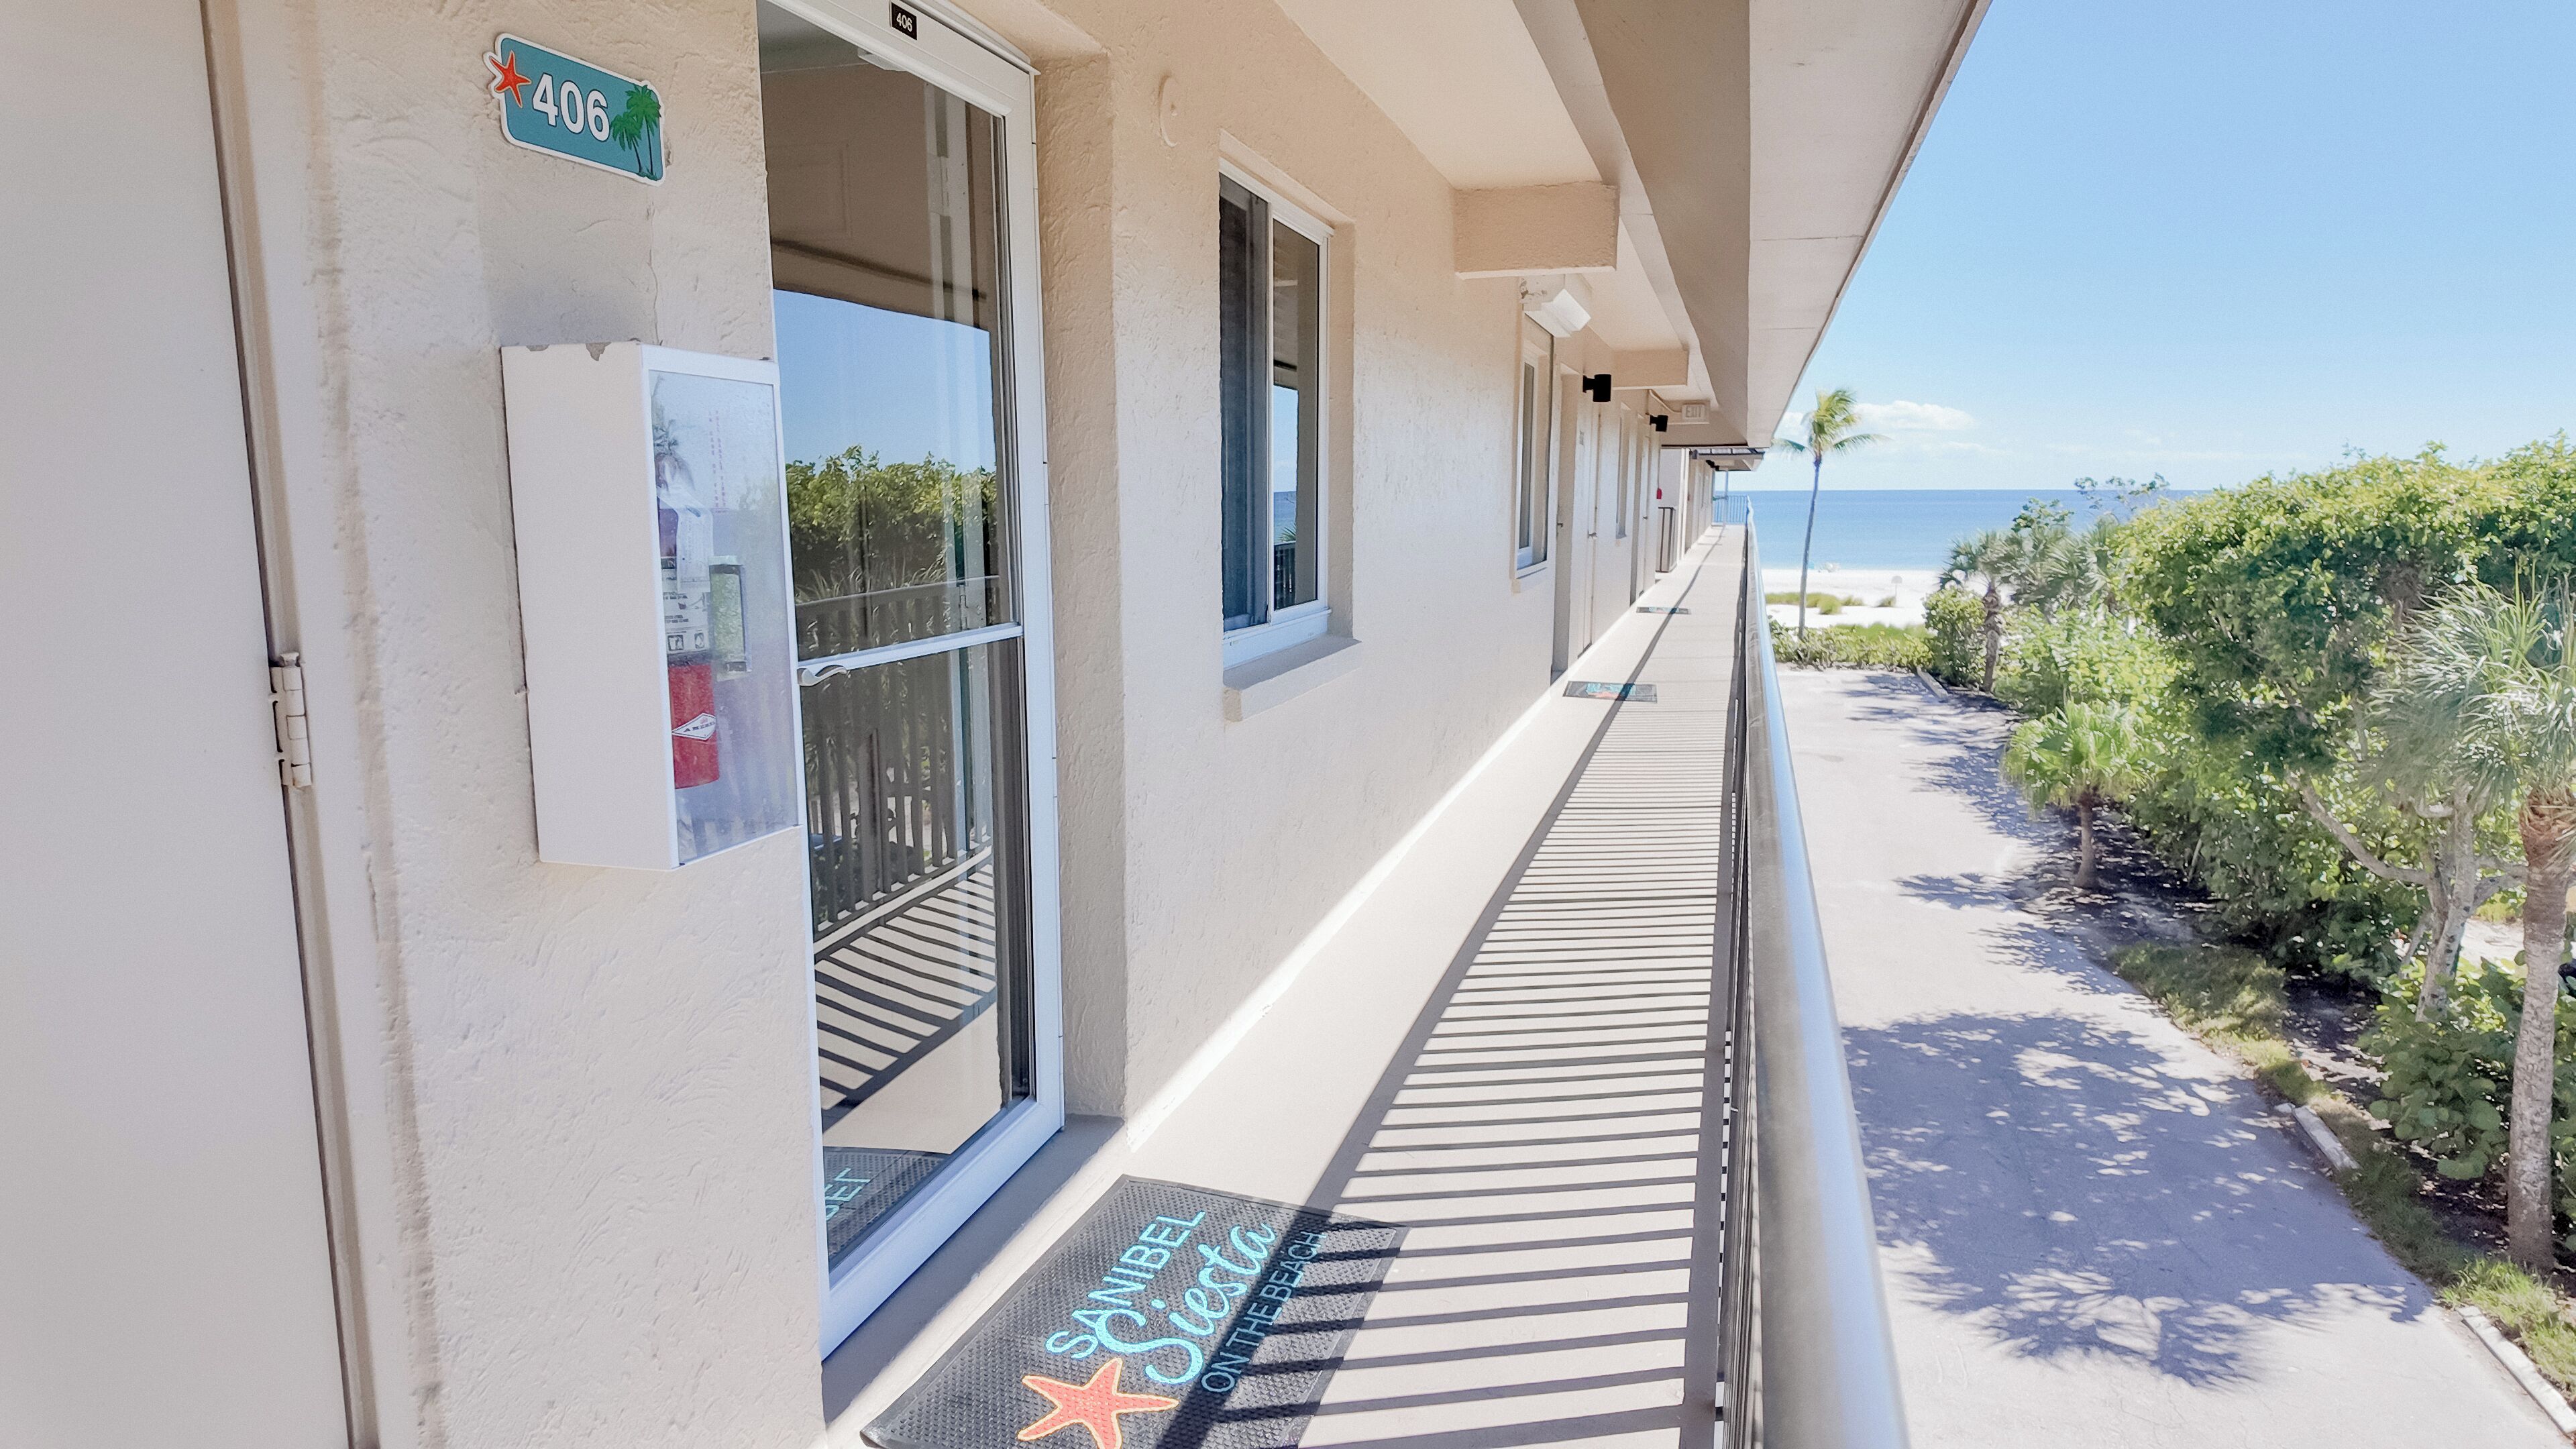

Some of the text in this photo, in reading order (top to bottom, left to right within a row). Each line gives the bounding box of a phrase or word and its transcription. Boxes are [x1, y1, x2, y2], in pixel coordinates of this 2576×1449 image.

[896, 12, 913, 32] 406
[532, 72, 611, 143] 406
[1044, 1210, 1206, 1360] SANIBEL
[1094, 1222, 1277, 1385] Siesta
[1201, 1230, 1328, 1393] ON THE BEACH
